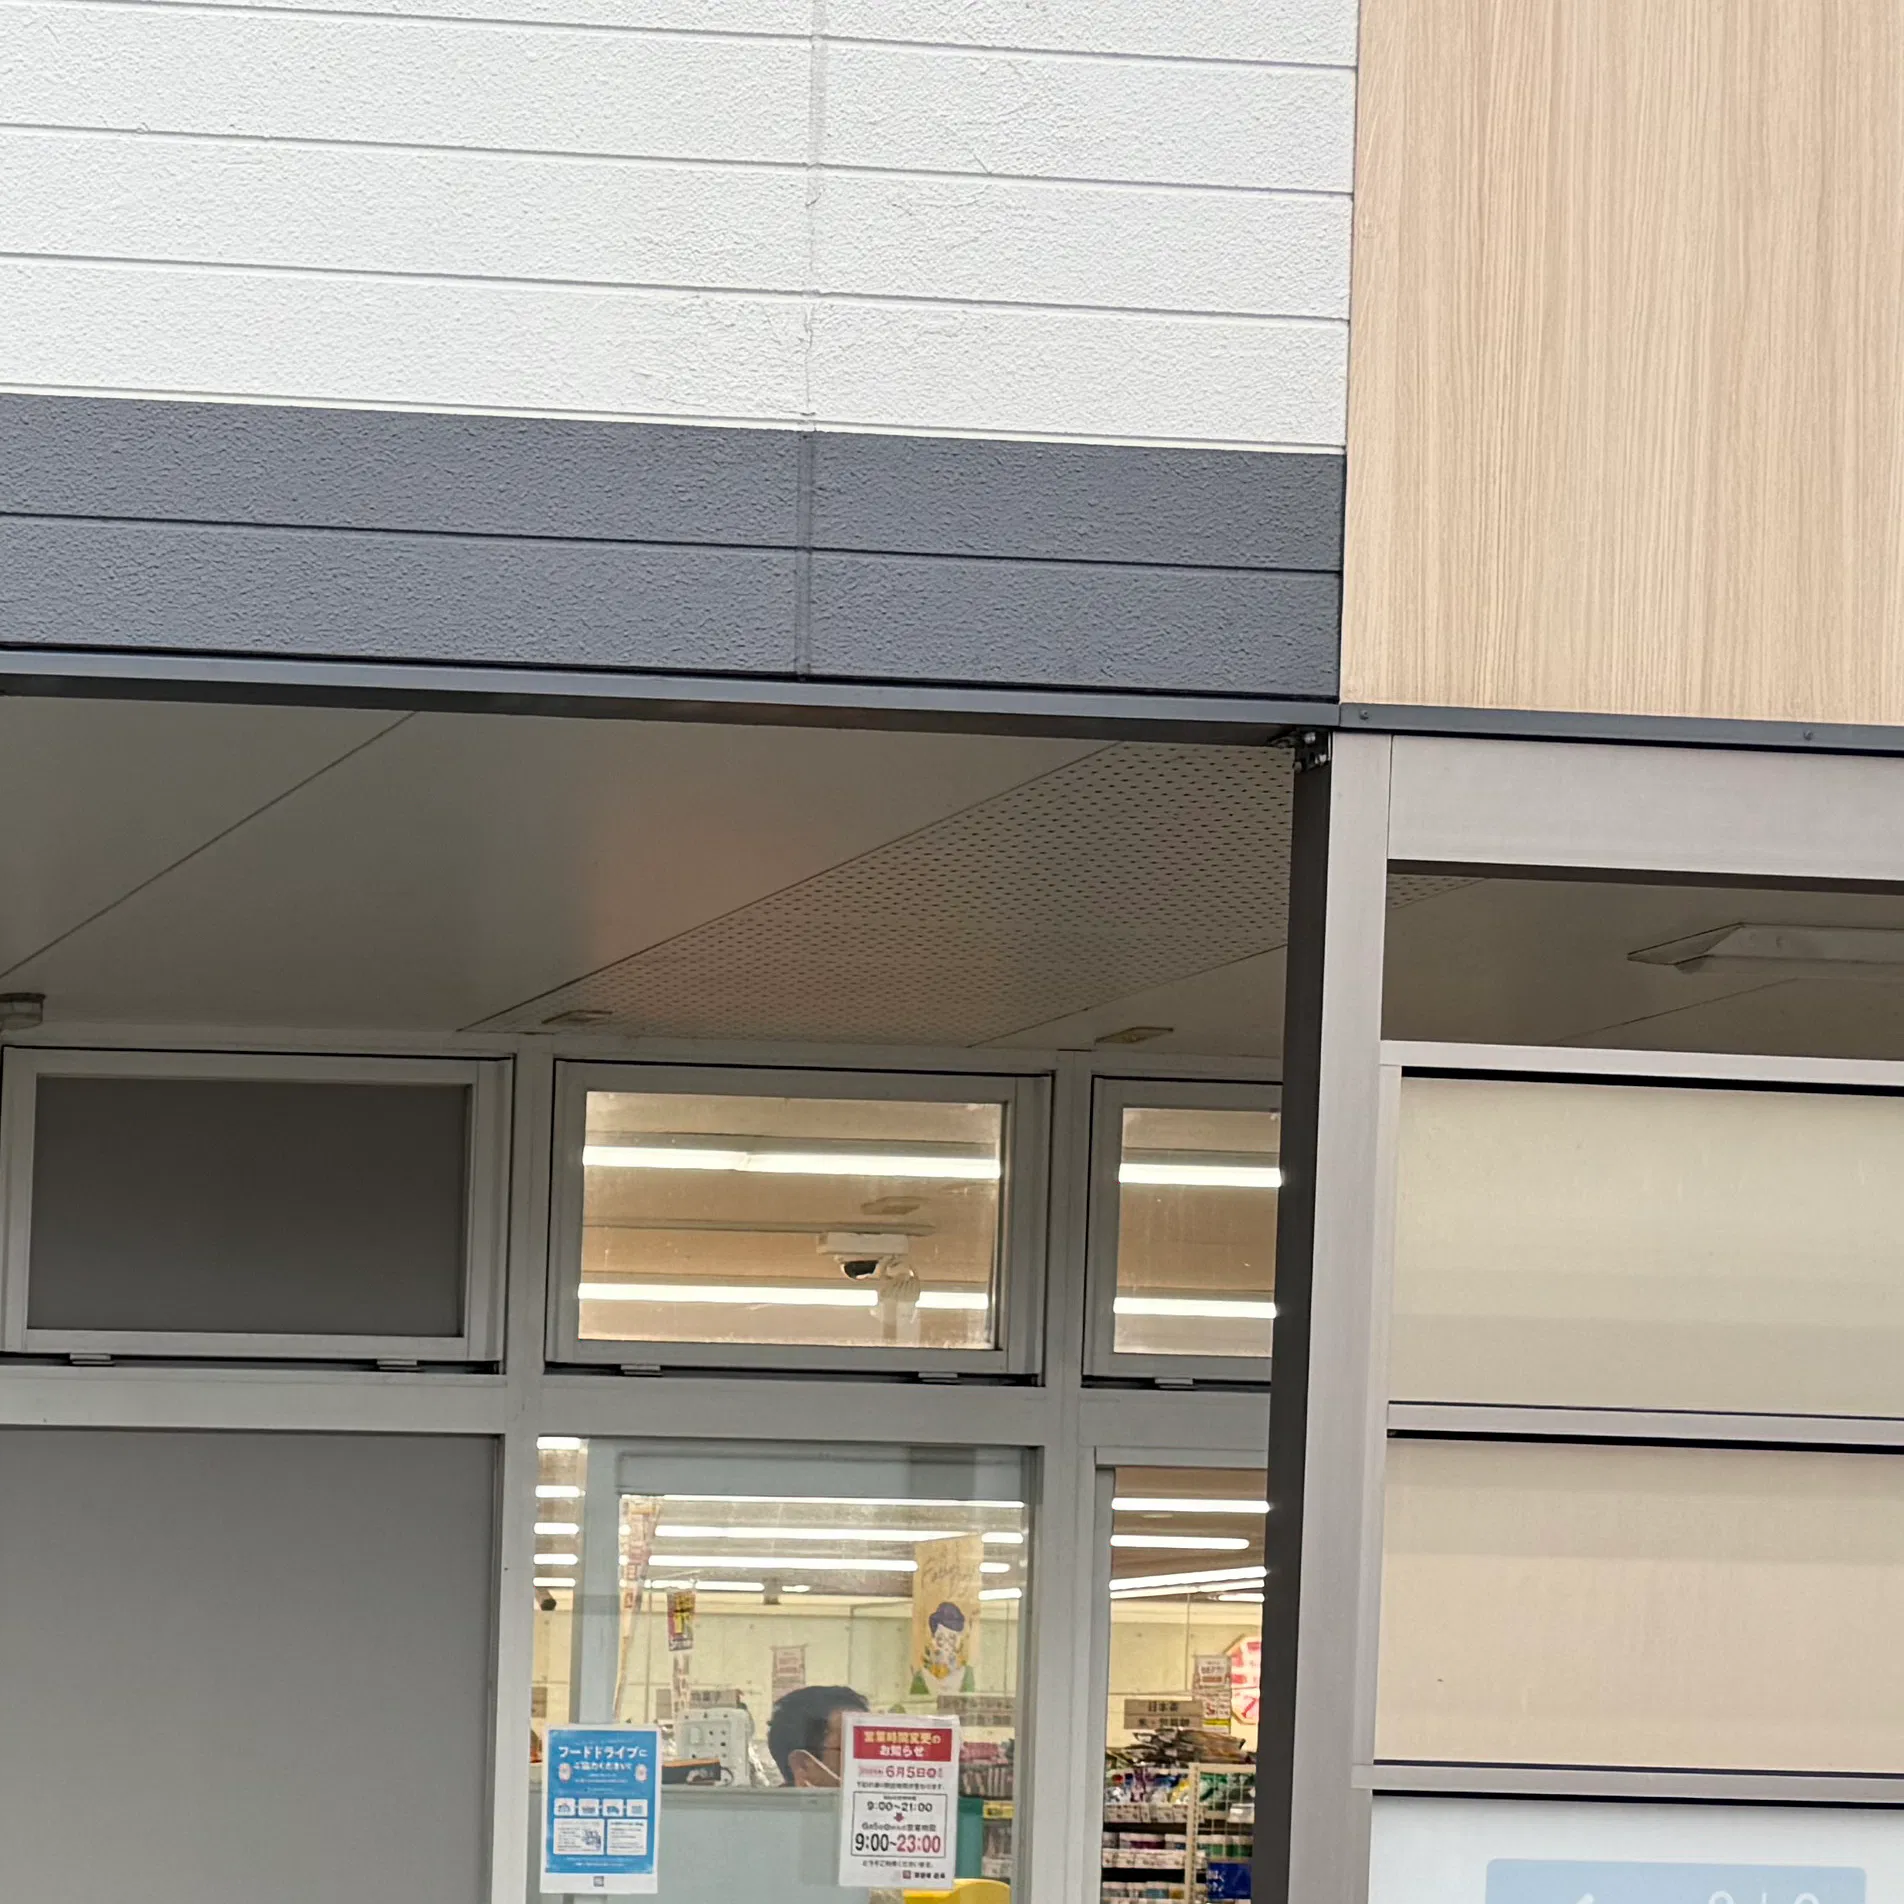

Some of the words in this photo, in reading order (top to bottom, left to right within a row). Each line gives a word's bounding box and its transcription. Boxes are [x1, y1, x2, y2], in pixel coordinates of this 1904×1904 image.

[558, 1745, 648, 1760] フードドライブに
[879, 1745, 925, 1757] お知らせ
